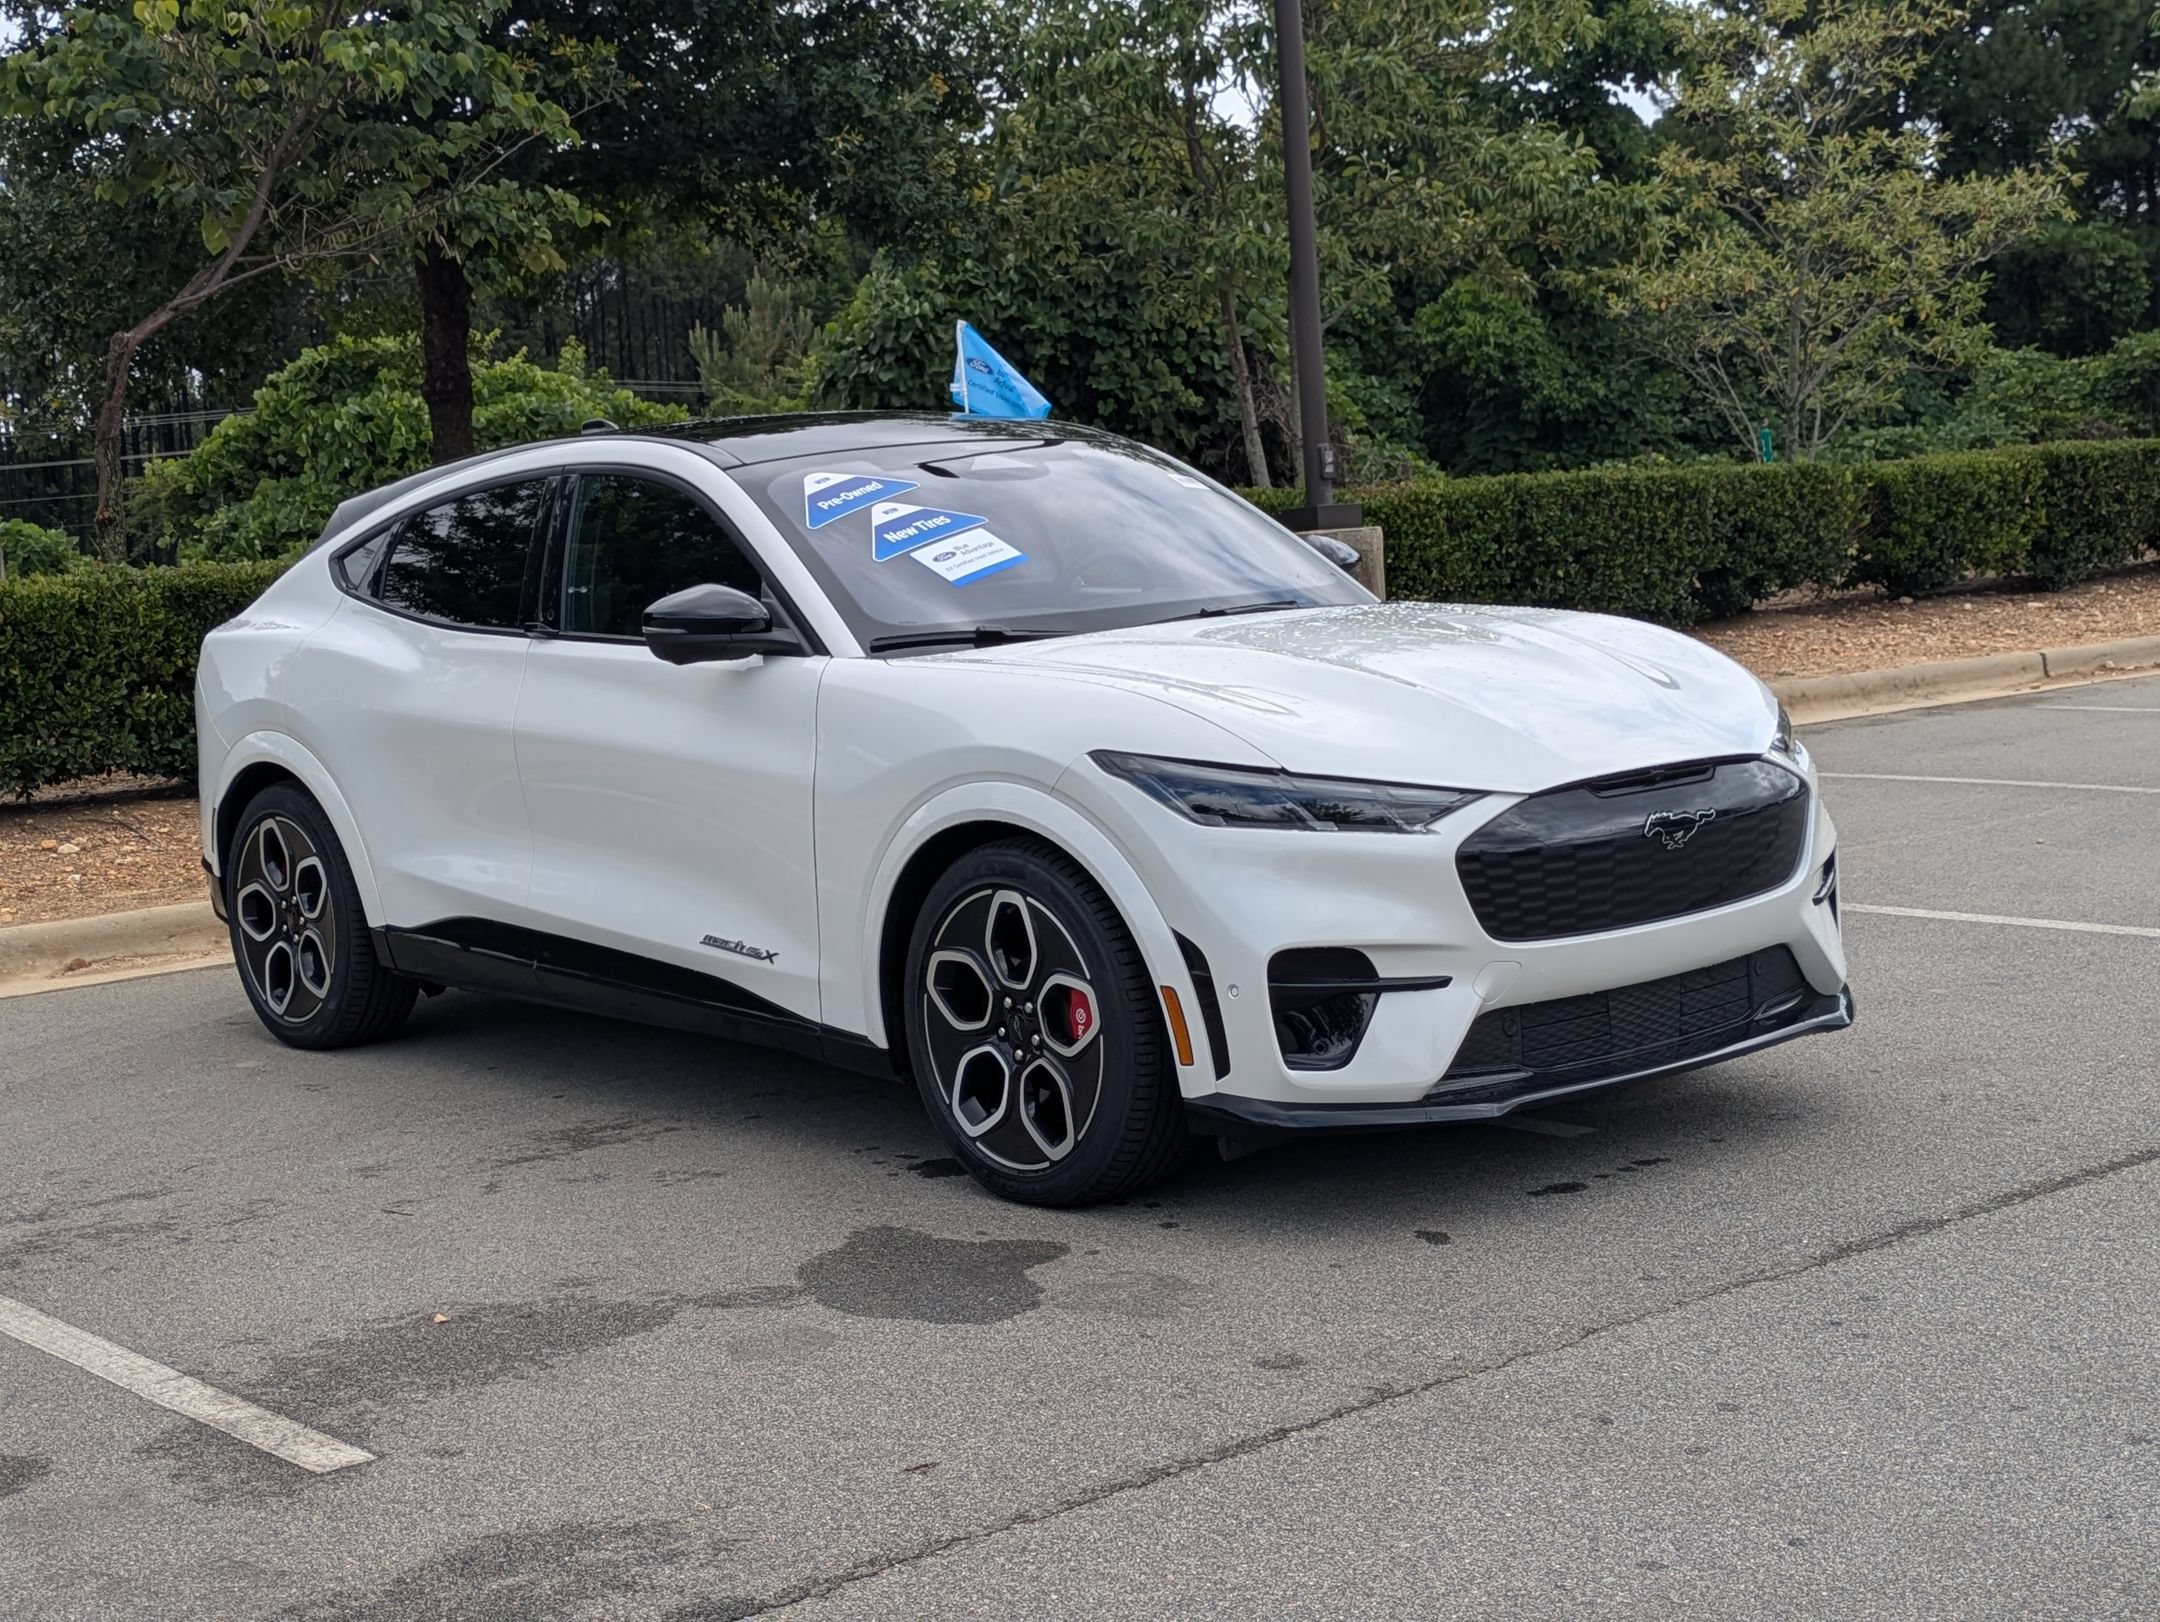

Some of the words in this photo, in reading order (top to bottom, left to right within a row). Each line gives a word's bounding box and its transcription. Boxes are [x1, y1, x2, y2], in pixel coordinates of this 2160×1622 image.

[817, 481, 884, 510] Pre-Owned
[883, 526, 919, 543] New
[912, 516, 951, 531] Tires
